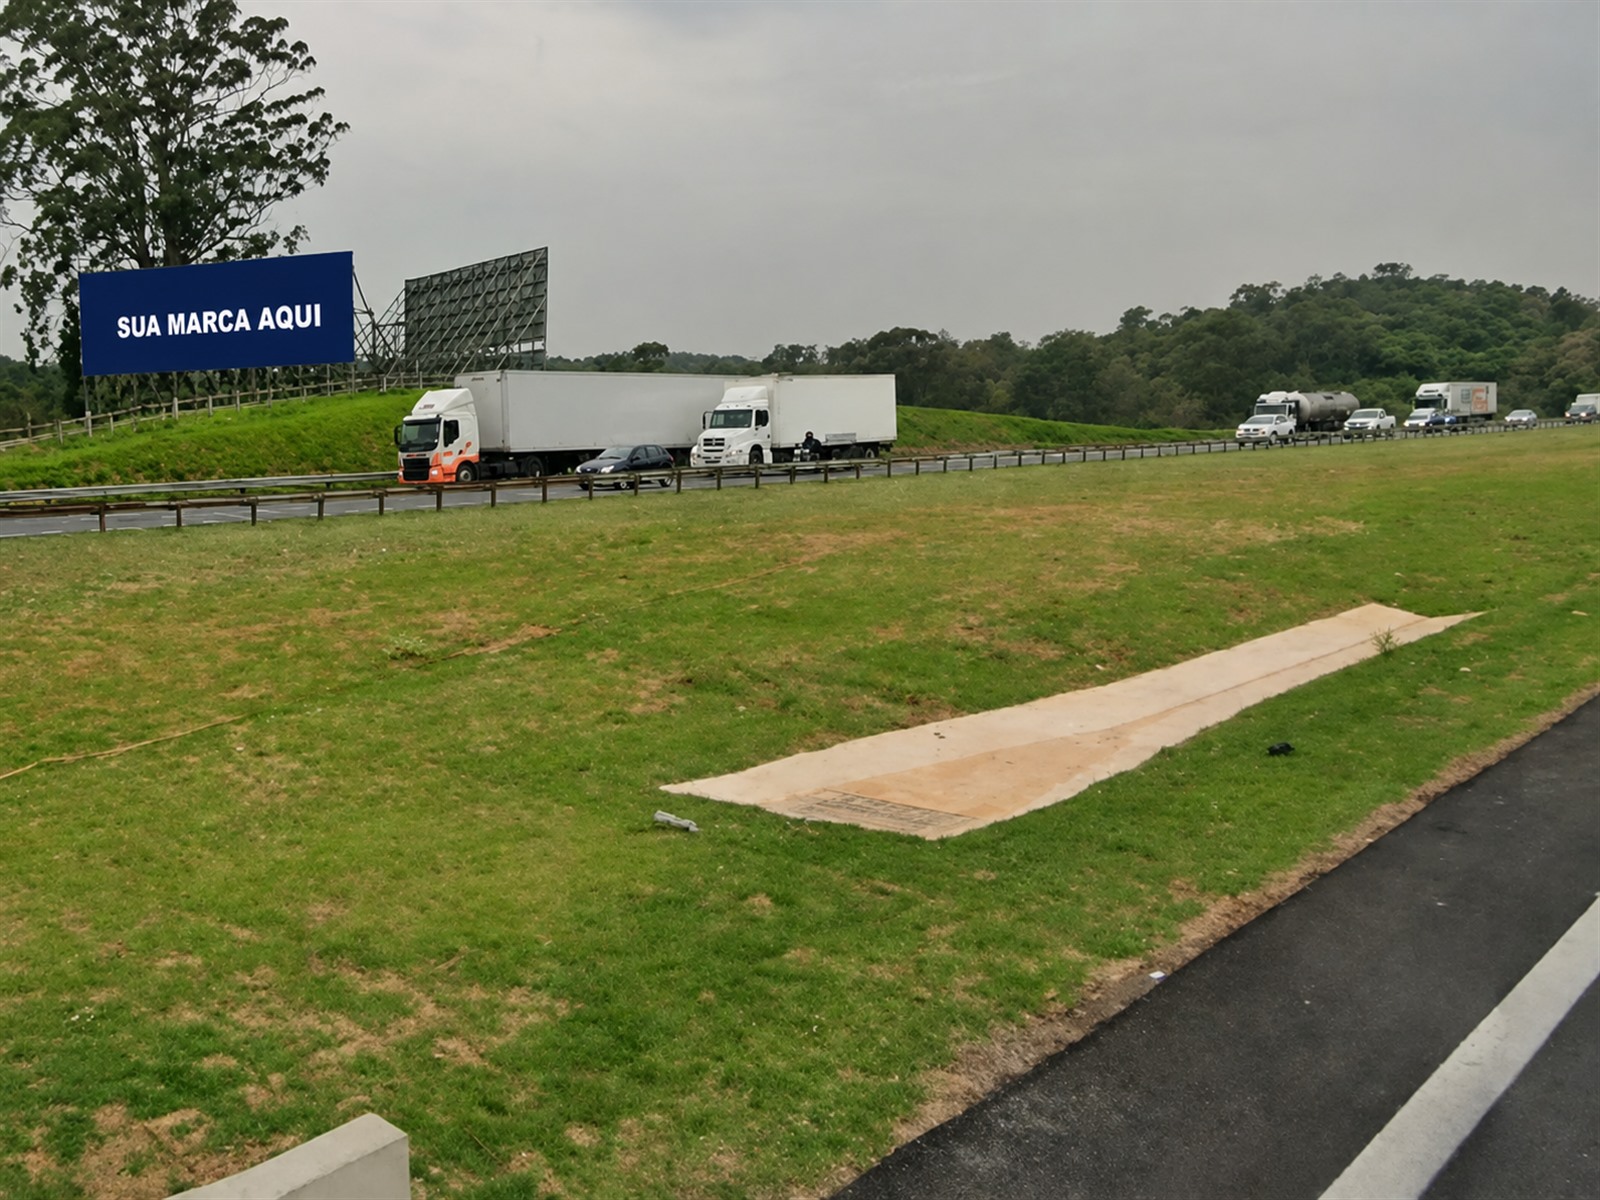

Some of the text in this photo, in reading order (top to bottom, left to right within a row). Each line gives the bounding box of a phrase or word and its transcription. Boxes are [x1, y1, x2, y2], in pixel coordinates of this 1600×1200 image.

[118, 303, 321, 338] SUA MARCA AQUI
